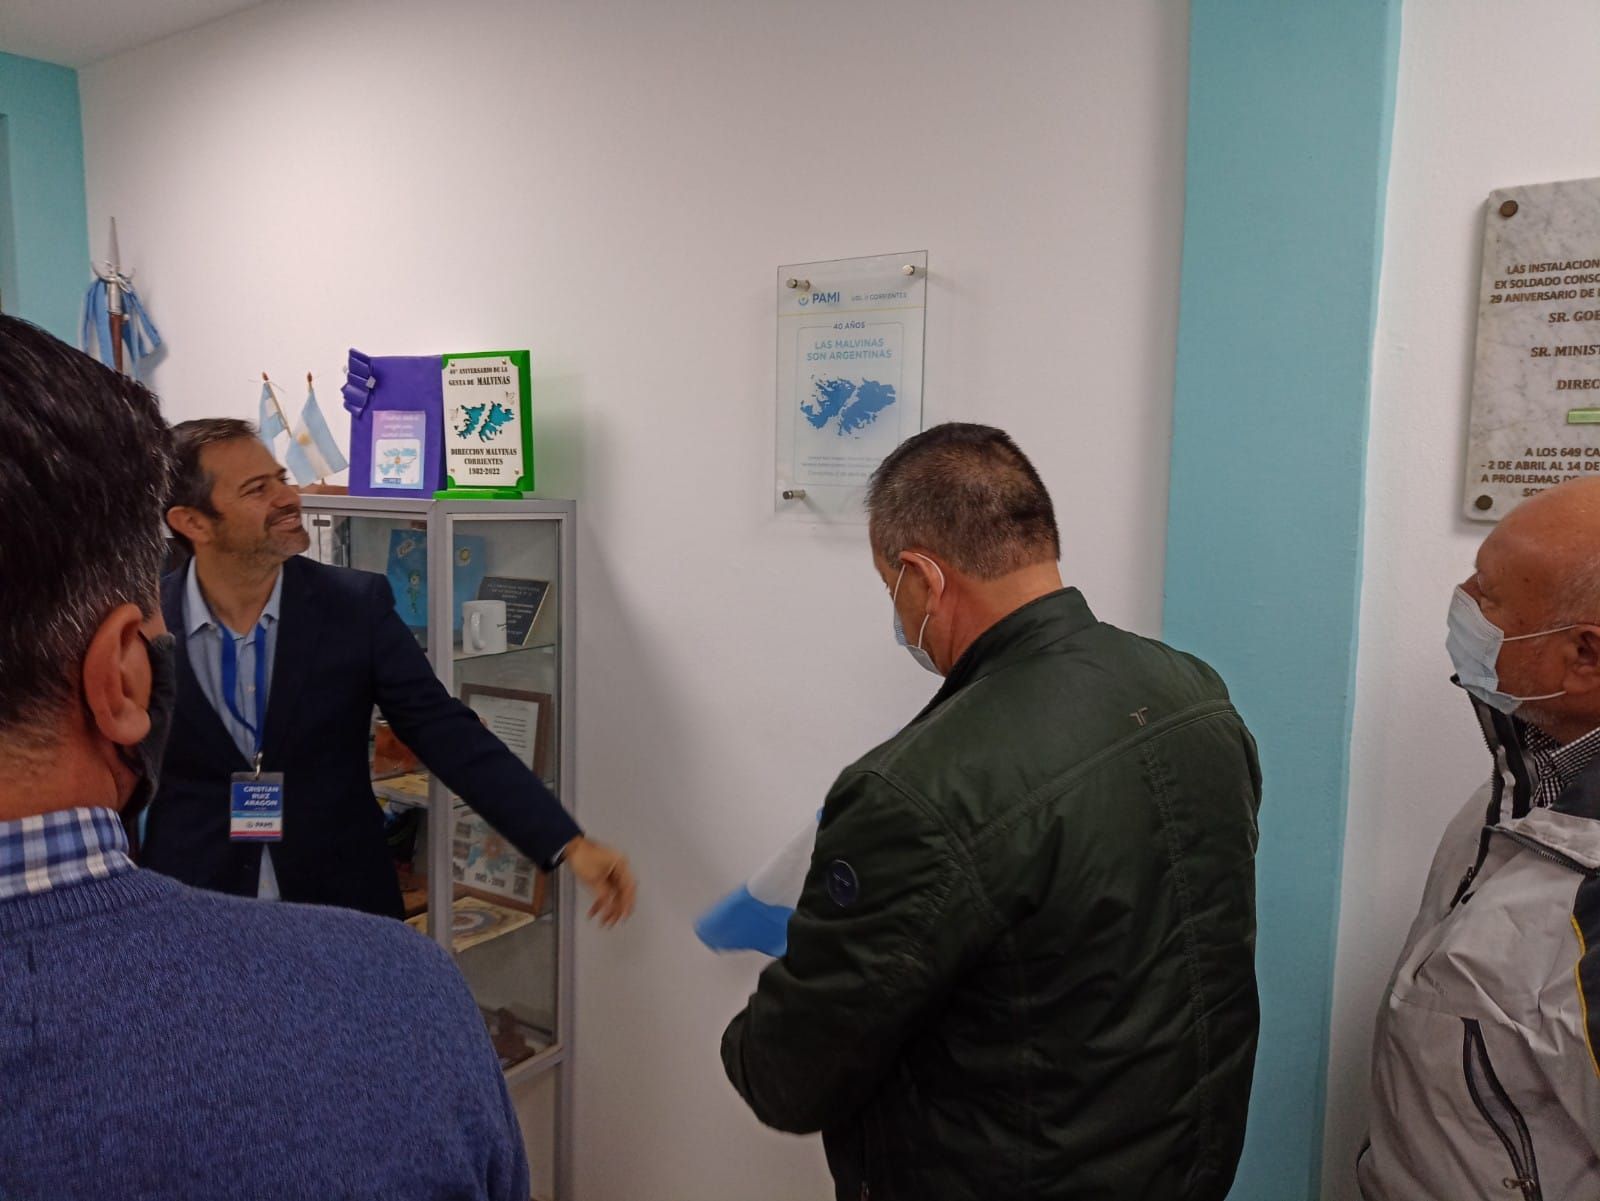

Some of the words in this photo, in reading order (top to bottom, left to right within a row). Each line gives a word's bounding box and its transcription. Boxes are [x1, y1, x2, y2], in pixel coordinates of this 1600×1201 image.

[1507, 265, 1526, 275] LAS
[1494, 280, 1506, 289] EX
[1510, 277, 1561, 288] SOLDADO
[813, 291, 840, 304] PAMI
[1490, 294, 1502, 304] 29
[1505, 290, 1577, 302] ANIVERSARIO
[1580, 289, 1594, 298] DE
[1549, 312, 1570, 323] SR.
[845, 320, 865, 328] AÑOS
[815, 340, 832, 349] LAS
[835, 338, 884, 348] MALVINAS
[806, 352, 827, 361] SON
[830, 350, 892, 360] ARGENTINAS
[1530, 347, 1551, 357] SR.
[477, 376, 510, 385] MALVINAS
[486, 448, 517, 456] MALVINAS
[1525, 448, 1533, 457] A
[1536, 448, 1557, 457] LOS
[1560, 448, 1581, 457] 649
[1488, 460, 1495, 470] 2
[1498, 461, 1512, 470] DE
[1515, 461, 1547, 470] ABRIL
[1550, 462, 1564, 470] AL
[1567, 461, 1581, 470] 14
[1584, 461, 1600, 471] DE
[469, 467, 500, 475] 1982-2022
[1481, 474, 1489, 482] A
[1492, 474, 1560, 484] PROBLEMAS
